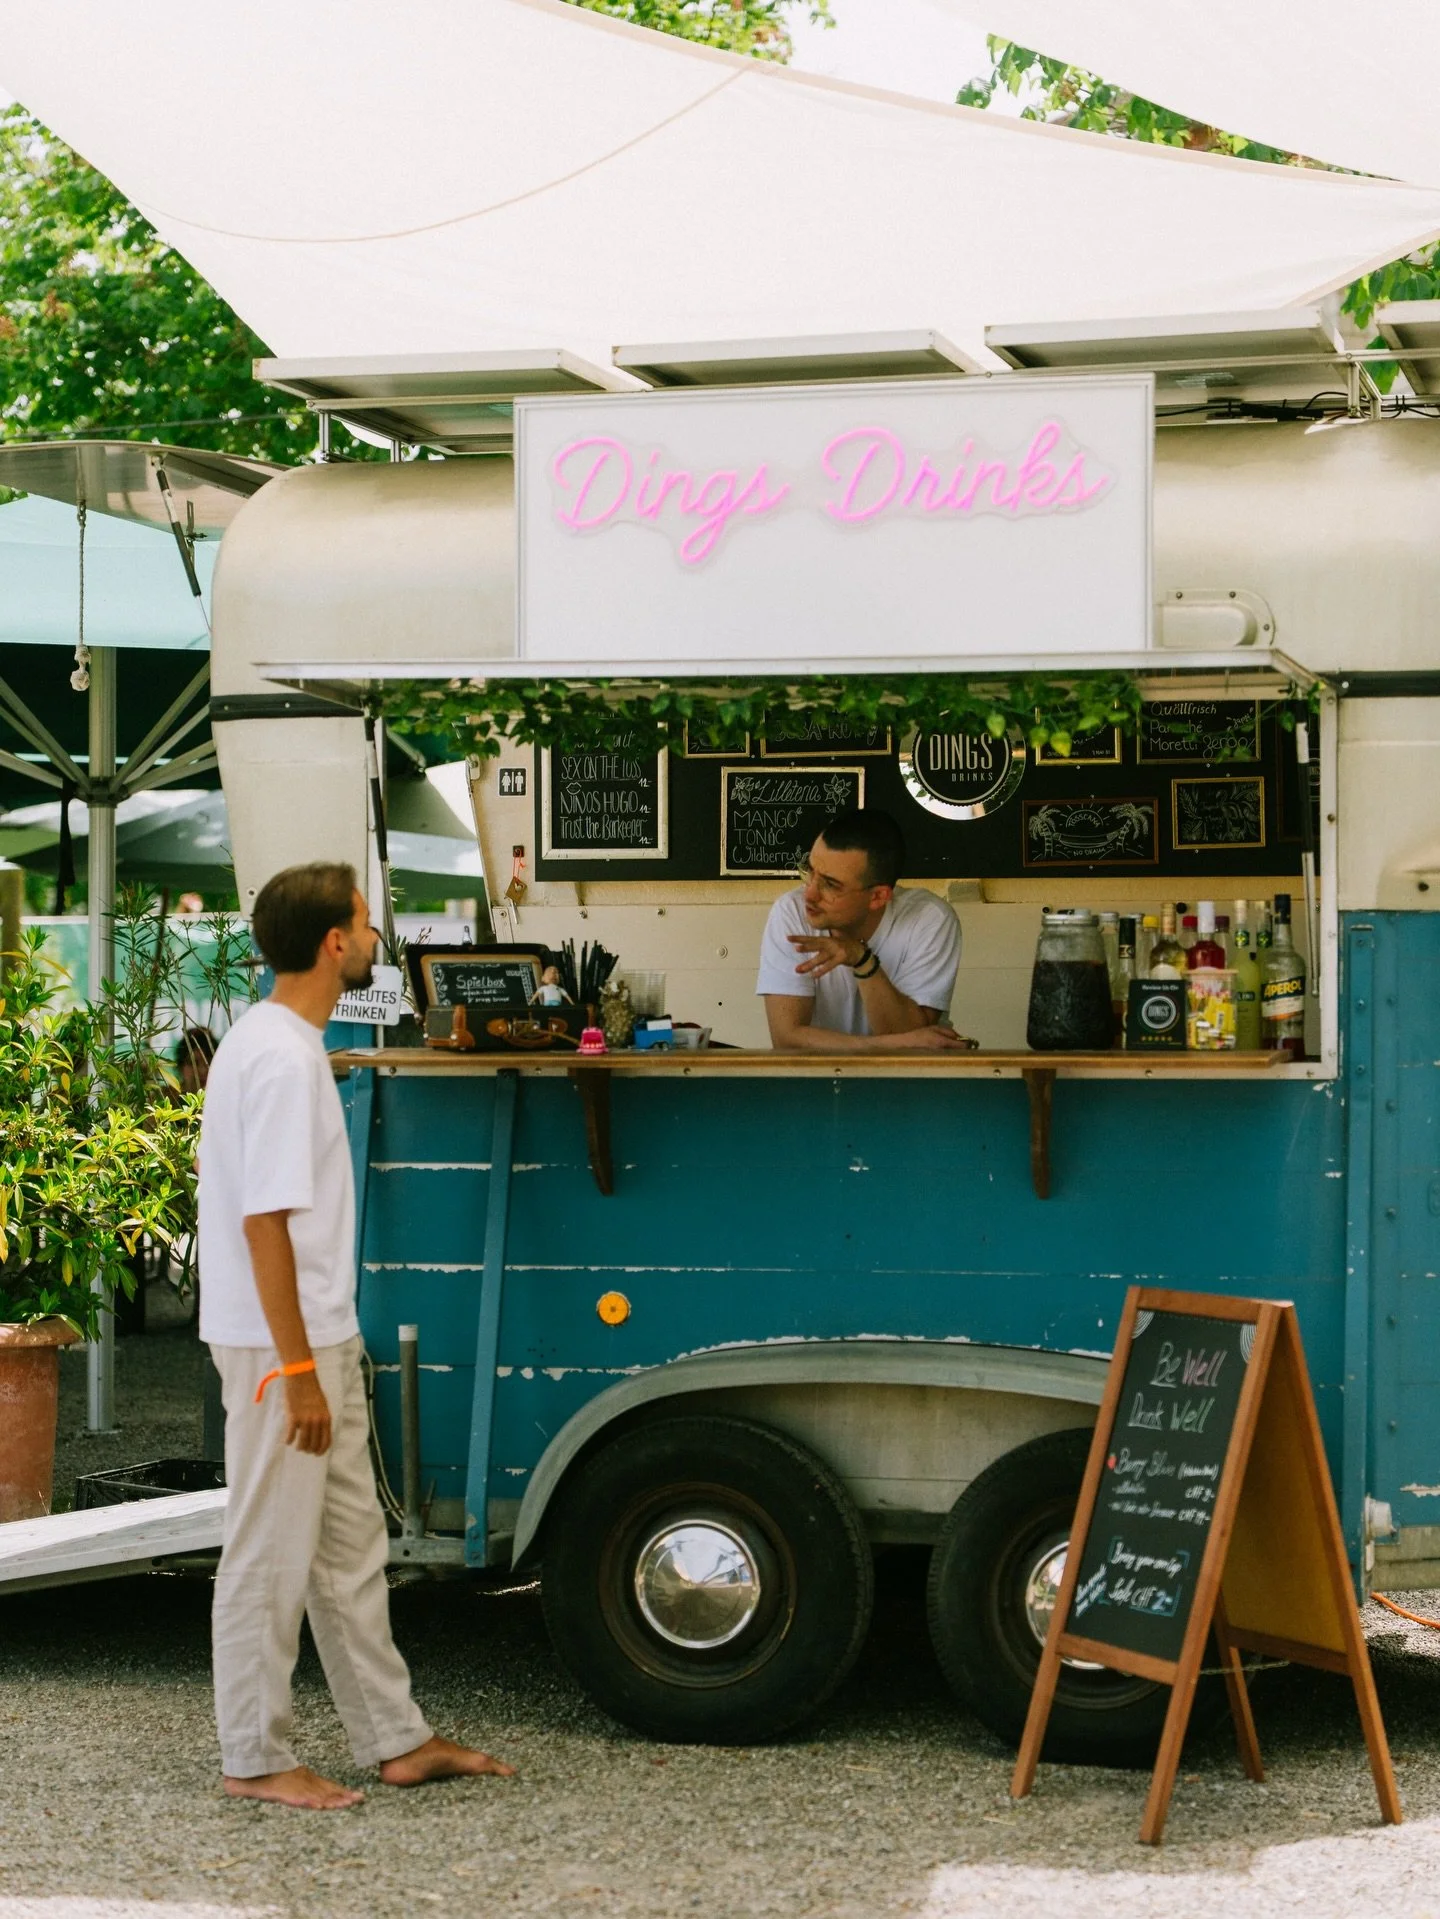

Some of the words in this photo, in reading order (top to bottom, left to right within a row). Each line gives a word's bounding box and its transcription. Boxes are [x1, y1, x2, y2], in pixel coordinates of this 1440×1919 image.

[553, 436, 791, 564] Dings
[822, 421, 1110, 521] Drinks
[930, 733, 993, 770] DINGS
[561, 756, 581, 780] SEX
[583, 756, 598, 780] ON
[600, 755, 619, 779] THE
[951, 772, 993, 782] DRINKS
[603, 790, 638, 813] HUGO
[560, 816, 584, 839] Trust
[585, 815, 600, 839] the
[733, 809, 799, 828] MANGO
[732, 846, 798, 870] Wildberry
[456, 975, 506, 990] Spielbox
[1264, 980, 1302, 998] APEROL
[336, 1003, 387, 1020] TRINKEN
[1151, 1342, 1181, 1383] Be
[1182, 1349, 1228, 1387] Well
[1170, 1398, 1215, 1433] Well
